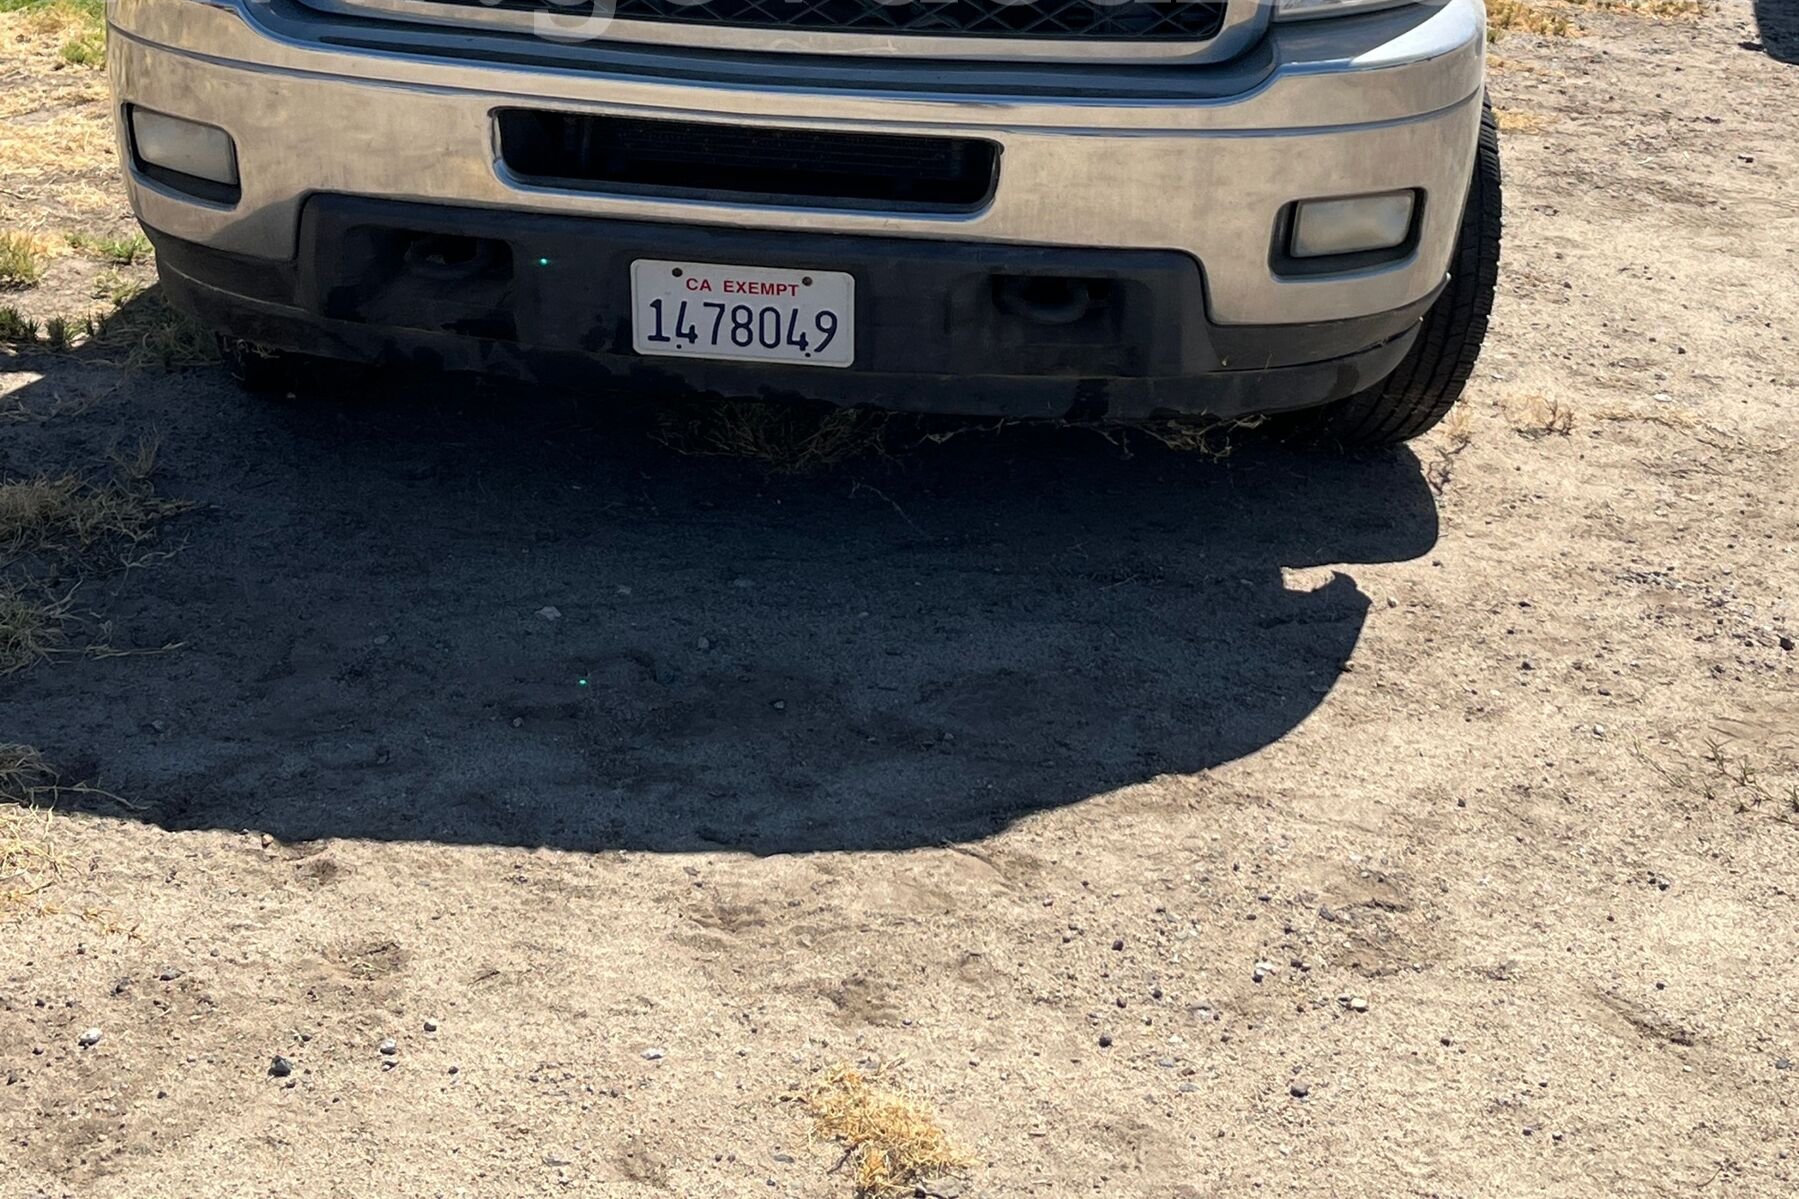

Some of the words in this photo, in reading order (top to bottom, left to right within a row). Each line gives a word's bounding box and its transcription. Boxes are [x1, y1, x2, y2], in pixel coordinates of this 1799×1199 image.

[685, 278, 712, 292] CA
[723, 280, 799, 297] EXEMPT
[647, 298, 838, 353] 1478049
